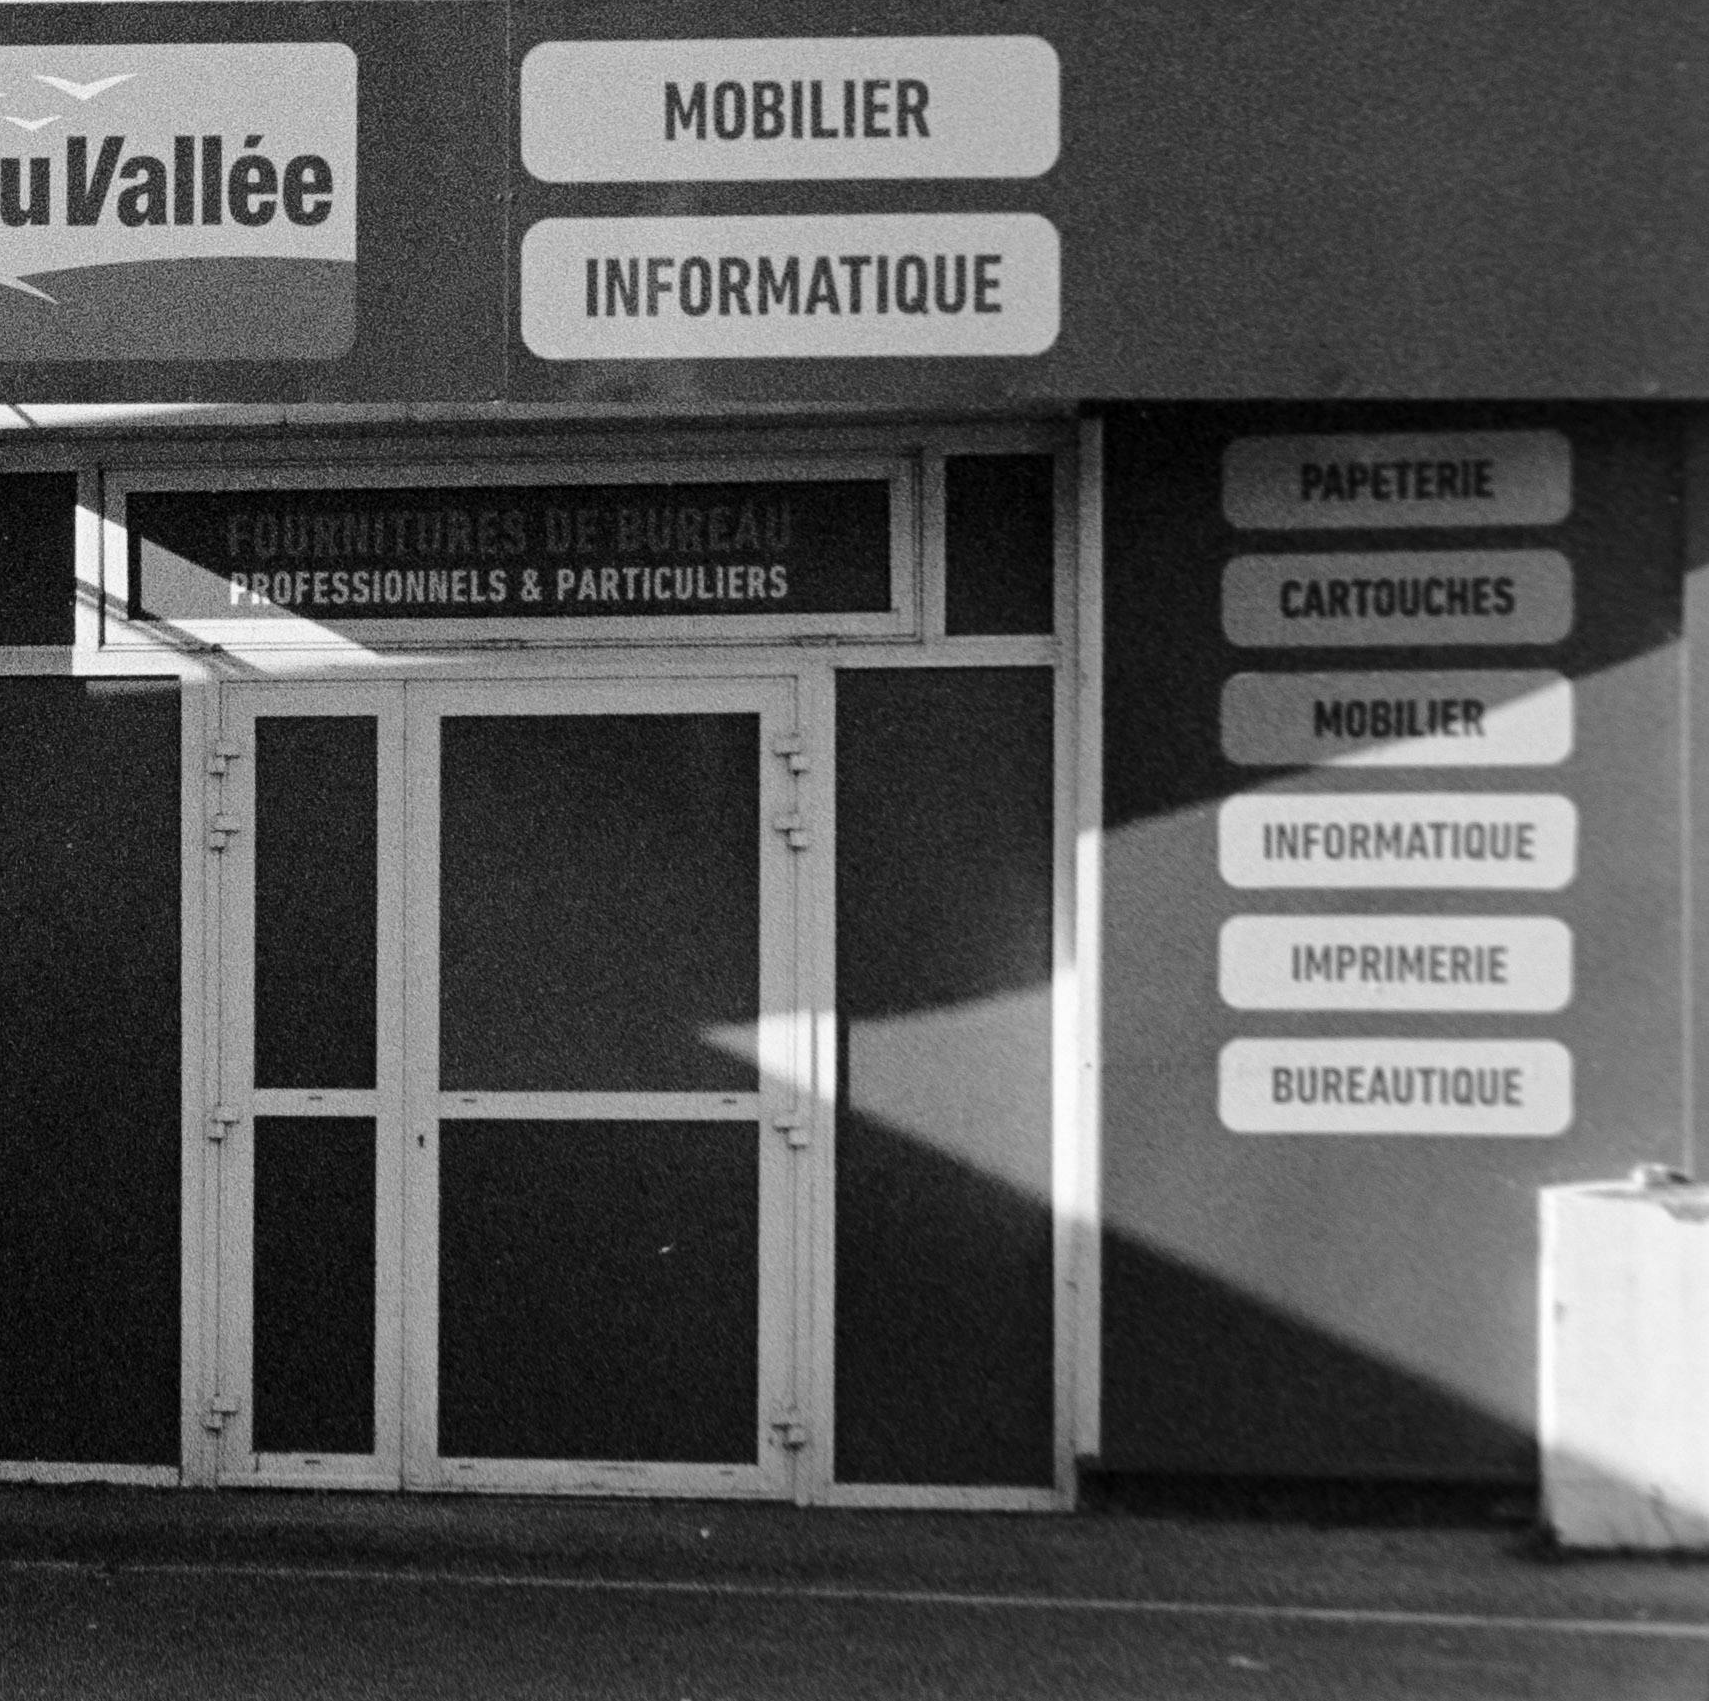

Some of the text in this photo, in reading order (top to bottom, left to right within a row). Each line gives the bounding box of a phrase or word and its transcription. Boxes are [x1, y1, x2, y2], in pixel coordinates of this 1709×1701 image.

[664, 79, 931, 141] MOBILIER
[66, 134, 334, 228] Vallée
[585, 254, 1003, 318] INFORMATIQUE
[1300, 458, 1496, 501] PAPETERIE
[227, 504, 791, 558] FOURNITURES DE BUREAU
[228, 565, 790, 605] PROFESSIONNELS & PARTICULIERS
[1279, 576, 1516, 619] CARTOUCHES
[1312, 699, 1487, 738] MOBILIER
[1262, 821, 1537, 861] INFORMATIQUE
[1290, 944, 1509, 984] IMPRIMERIE
[1270, 1066, 1525, 1106] BUREAUTIQUE
